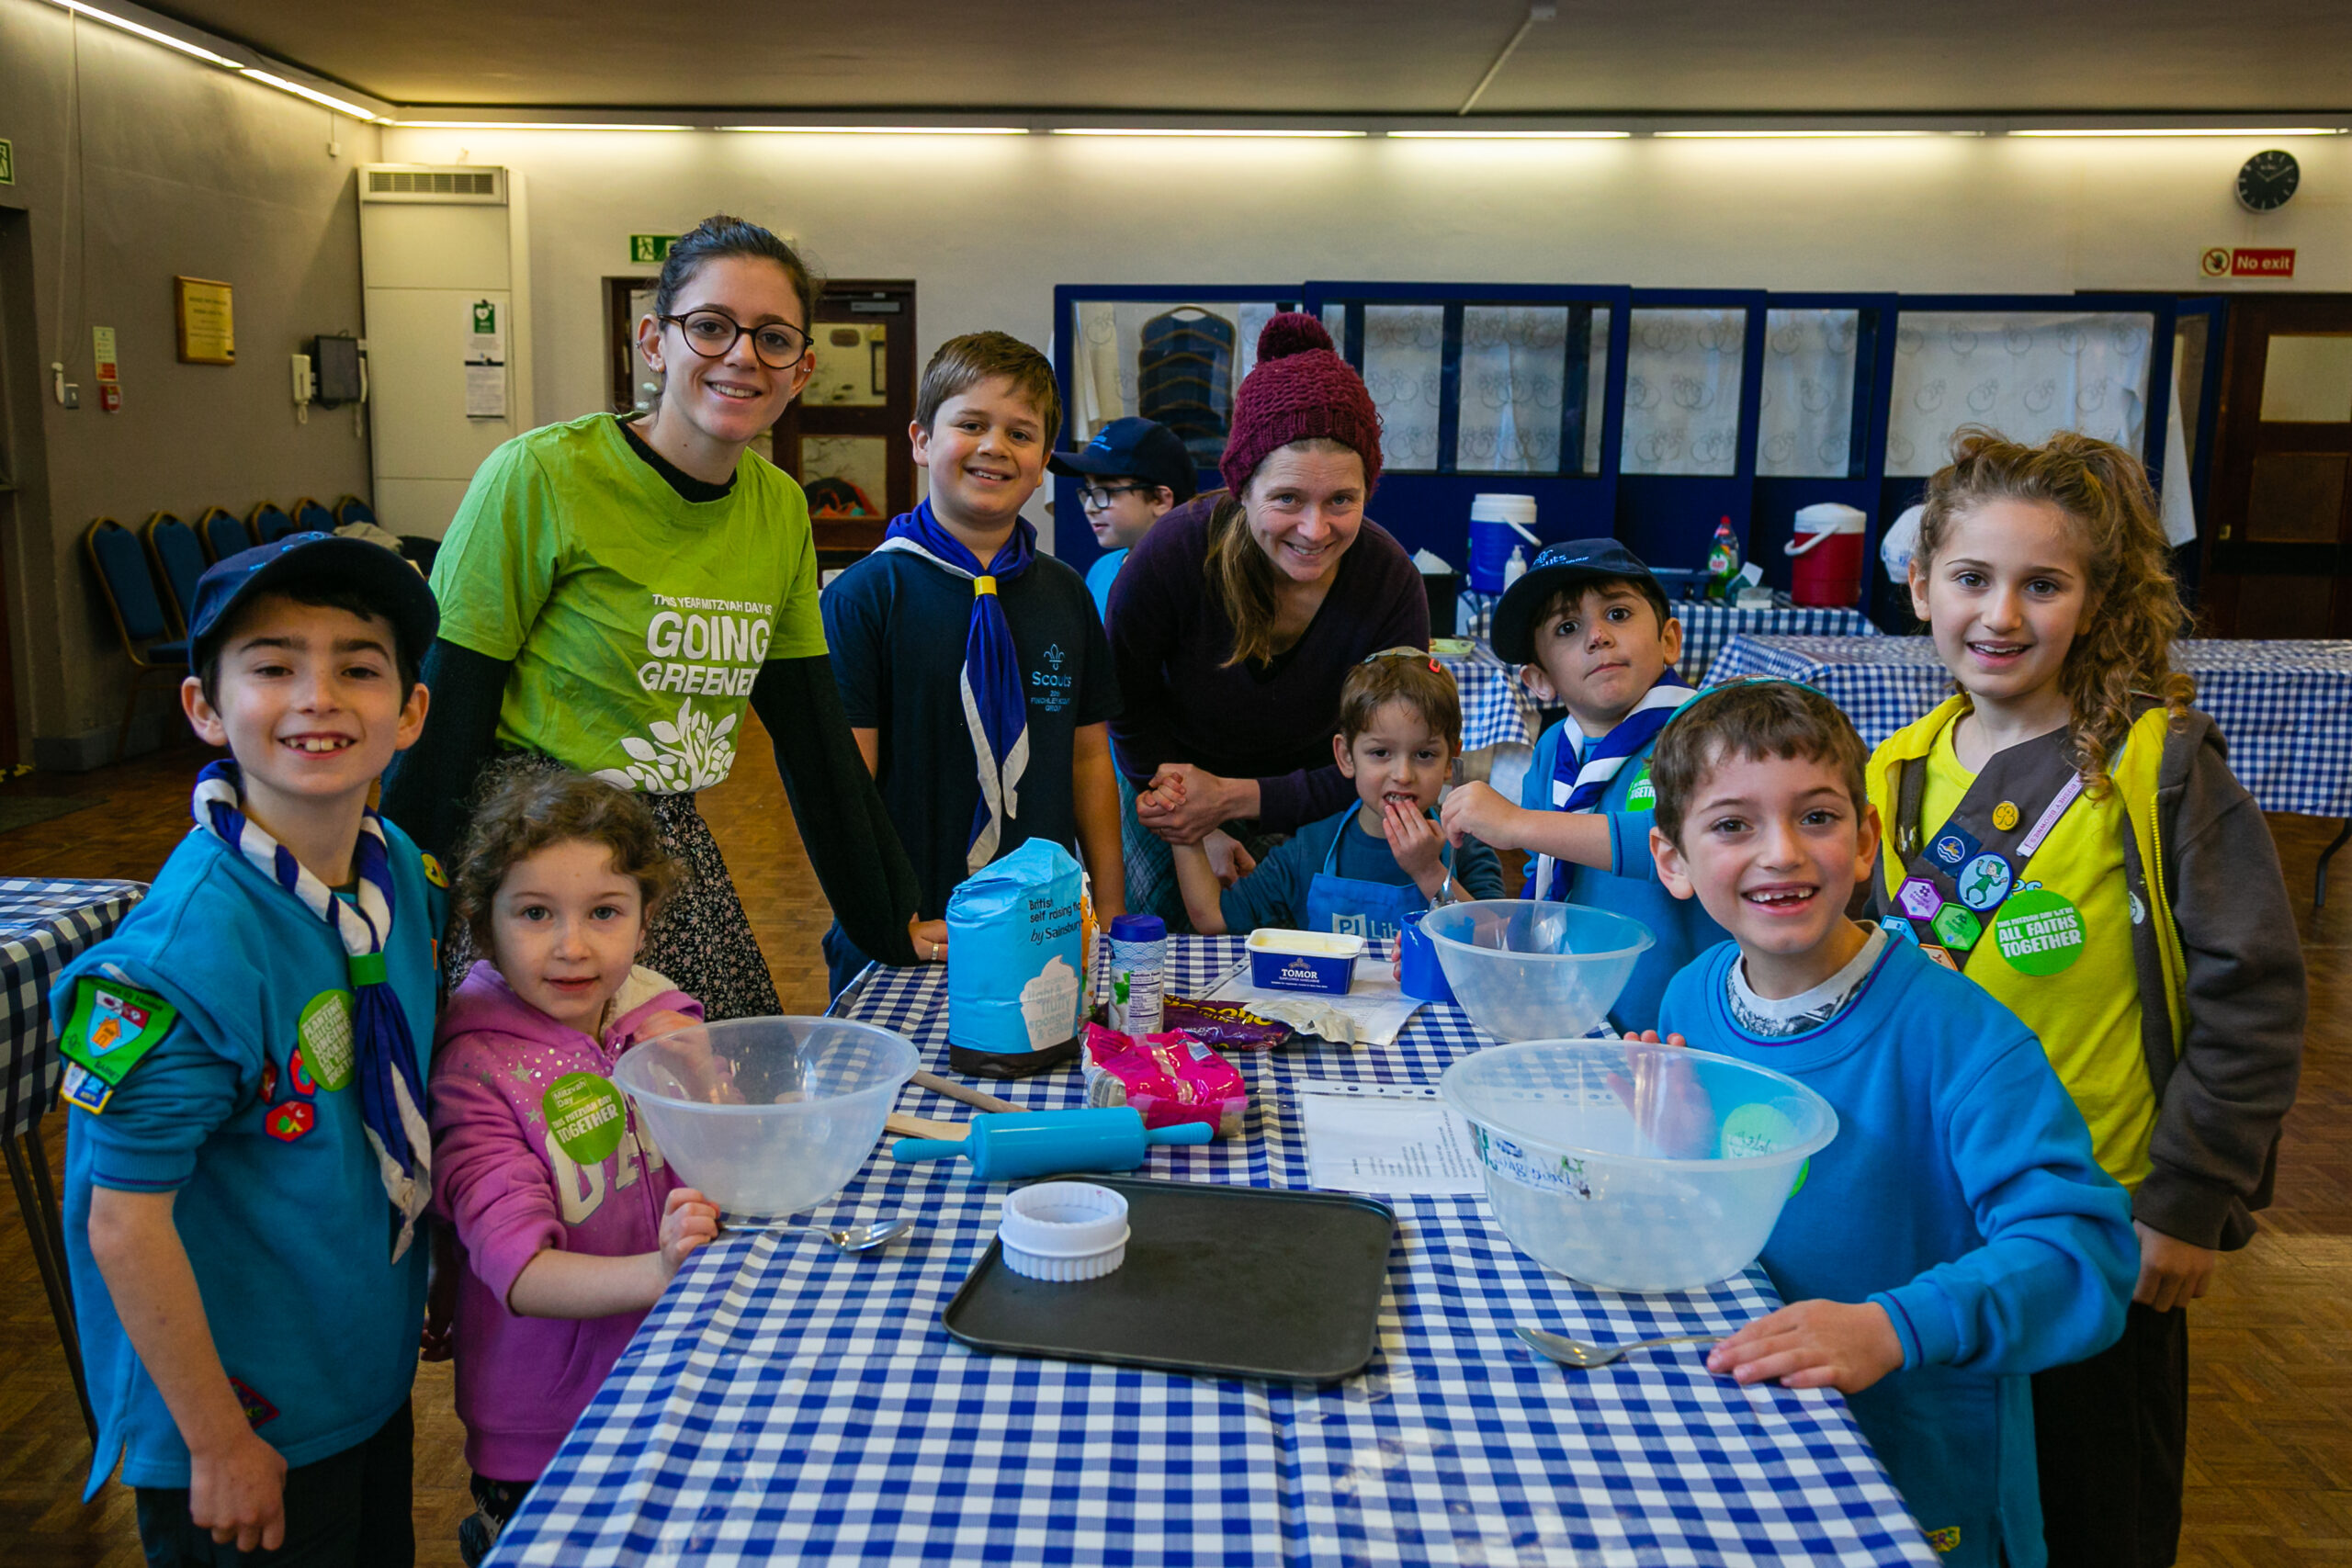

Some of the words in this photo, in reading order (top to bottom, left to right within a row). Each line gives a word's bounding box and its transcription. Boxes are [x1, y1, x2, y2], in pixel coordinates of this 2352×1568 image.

[2237, 256, 2258, 270] No
[2262, 256, 2290, 270] exit
[652, 594, 677, 607] THIS
[701, 599, 743, 611] MITZVAH
[745, 602, 764, 614] DAY
[764, 604, 773, 615] IS
[647, 611, 771, 663] GOING
[1032, 671, 1072, 687] Scouts
[2056, 784, 2076, 808] BUSHEY
[2030, 809, 2056, 842] BROWNIES
[1030, 910, 1046, 923] self
[1049, 905, 1072, 920] raising
[2040, 911, 2052, 919] DAY
[1031, 929, 1044, 945] by
[1340, 919, 1360, 935] PJ
[1371, 920, 1400, 939] Lib
[1998, 926, 2023, 942] ALL
[2026, 915, 2078, 937] FAITHS
[2000, 930, 2082, 957] TOGETHER
[1281, 968, 1317, 979] TOMOR
[553, 1080, 587, 1100] Mitzvah
[552, 1117, 565, 1129] THIS
[565, 1103, 597, 1122] MITZVAH
[599, 1094, 612, 1107] DAY
[557, 1097, 573, 1109] Day
[556, 1103, 619, 1144] TOGETHER
